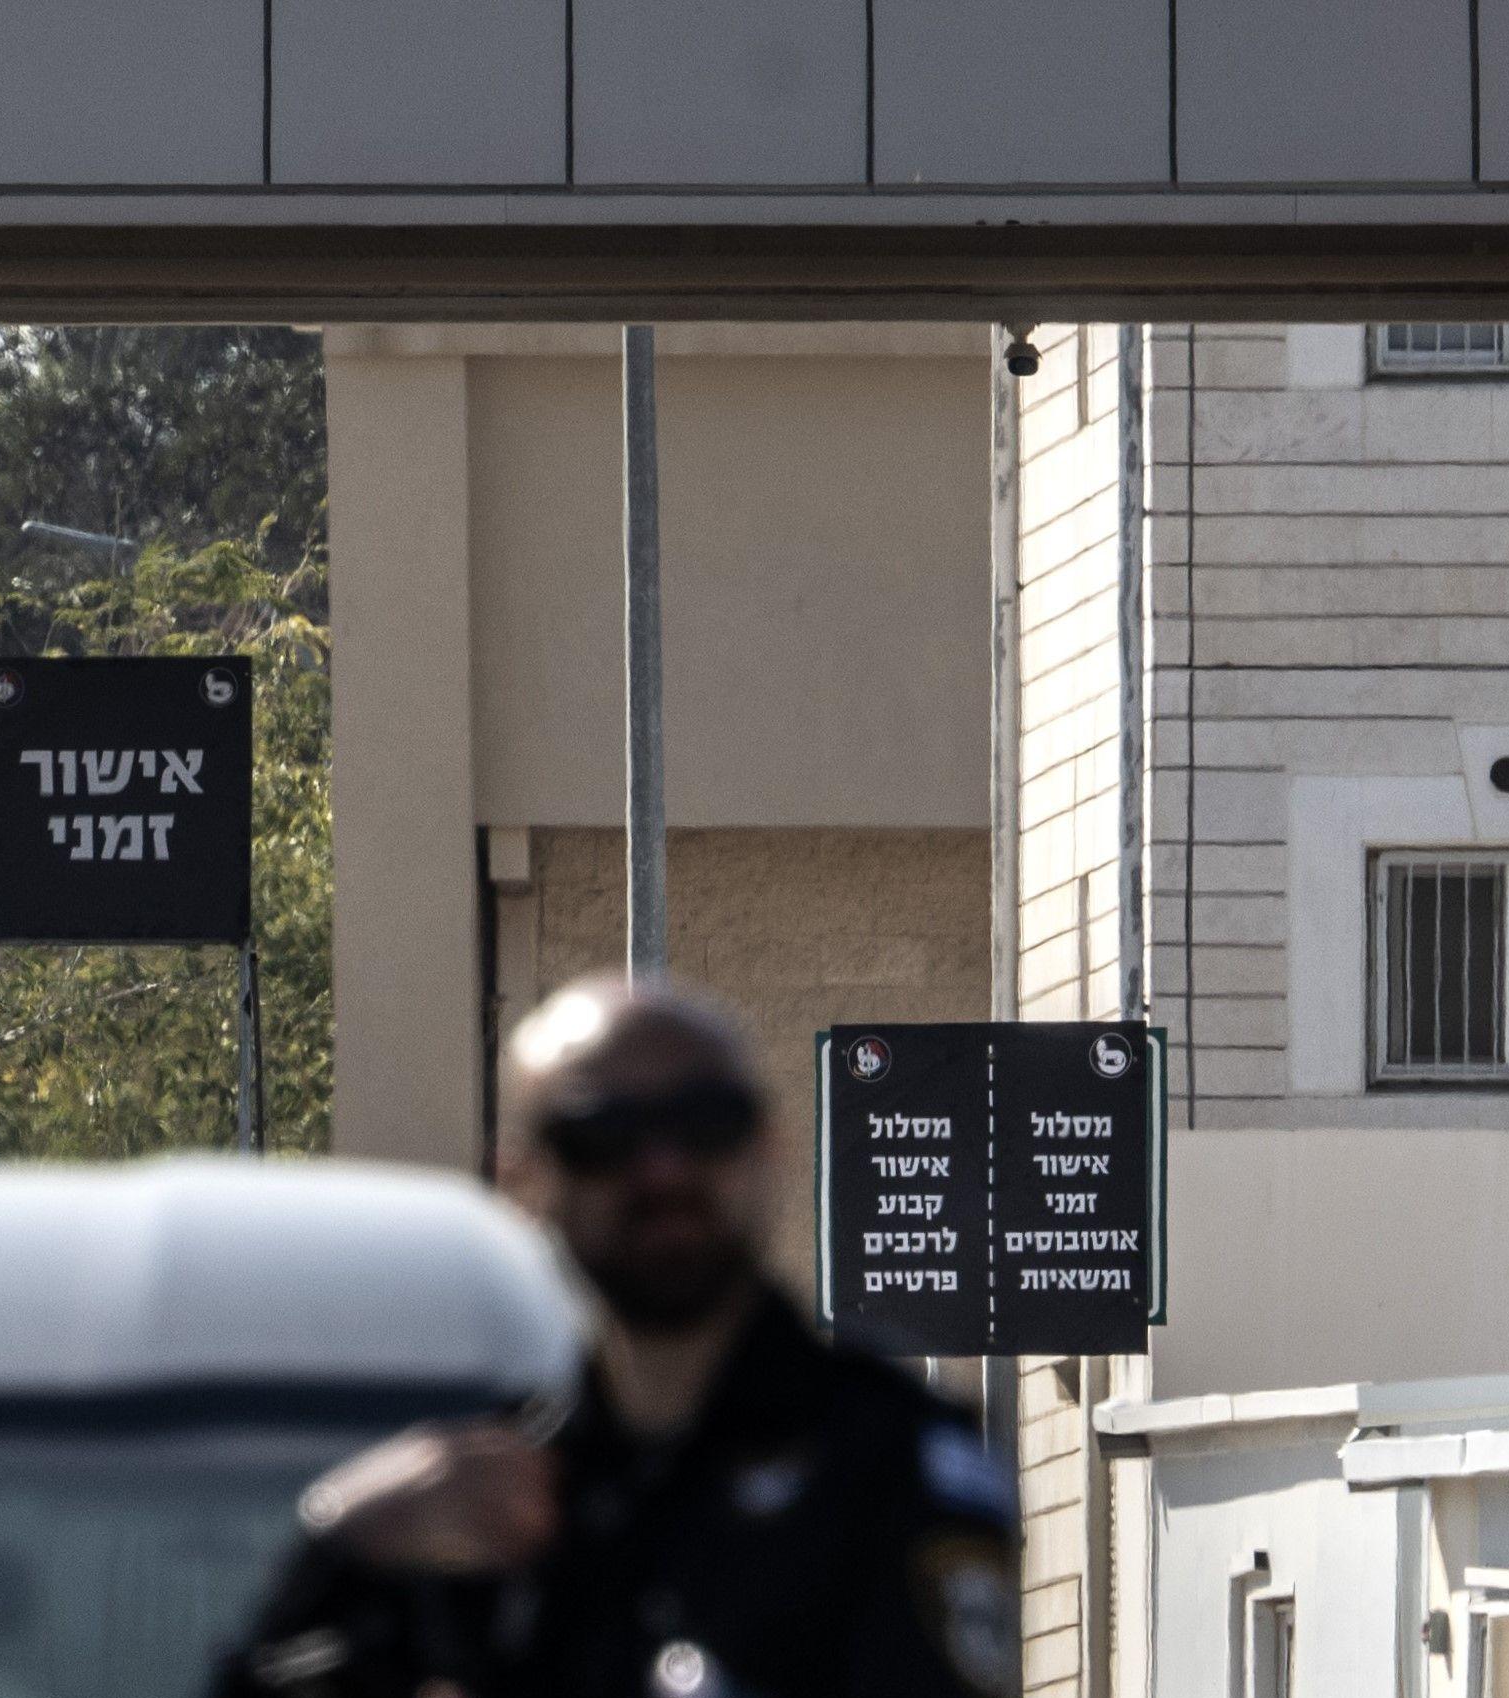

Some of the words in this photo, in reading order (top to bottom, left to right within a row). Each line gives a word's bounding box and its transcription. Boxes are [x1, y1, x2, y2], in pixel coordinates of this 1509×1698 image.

[20, 750, 203, 795] אישור
[48, 815, 174, 860] זמני
[869, 1113, 951, 1138] מסלול
[1031, 1111, 1111, 1137] מסלול
[872, 1157, 949, 1177] אישור
[1033, 1155, 1109, 1175] אישור
[878, 1195, 943, 1219] קבוע
[1046, 1193, 1097, 1213] זמני
[863, 1227, 957, 1254] לרכבים
[1005, 1231, 1137, 1252] אוטובוסים
[864, 1271, 957, 1291] פרטיים
[1021, 1269, 1130, 1289] ומשאיות
